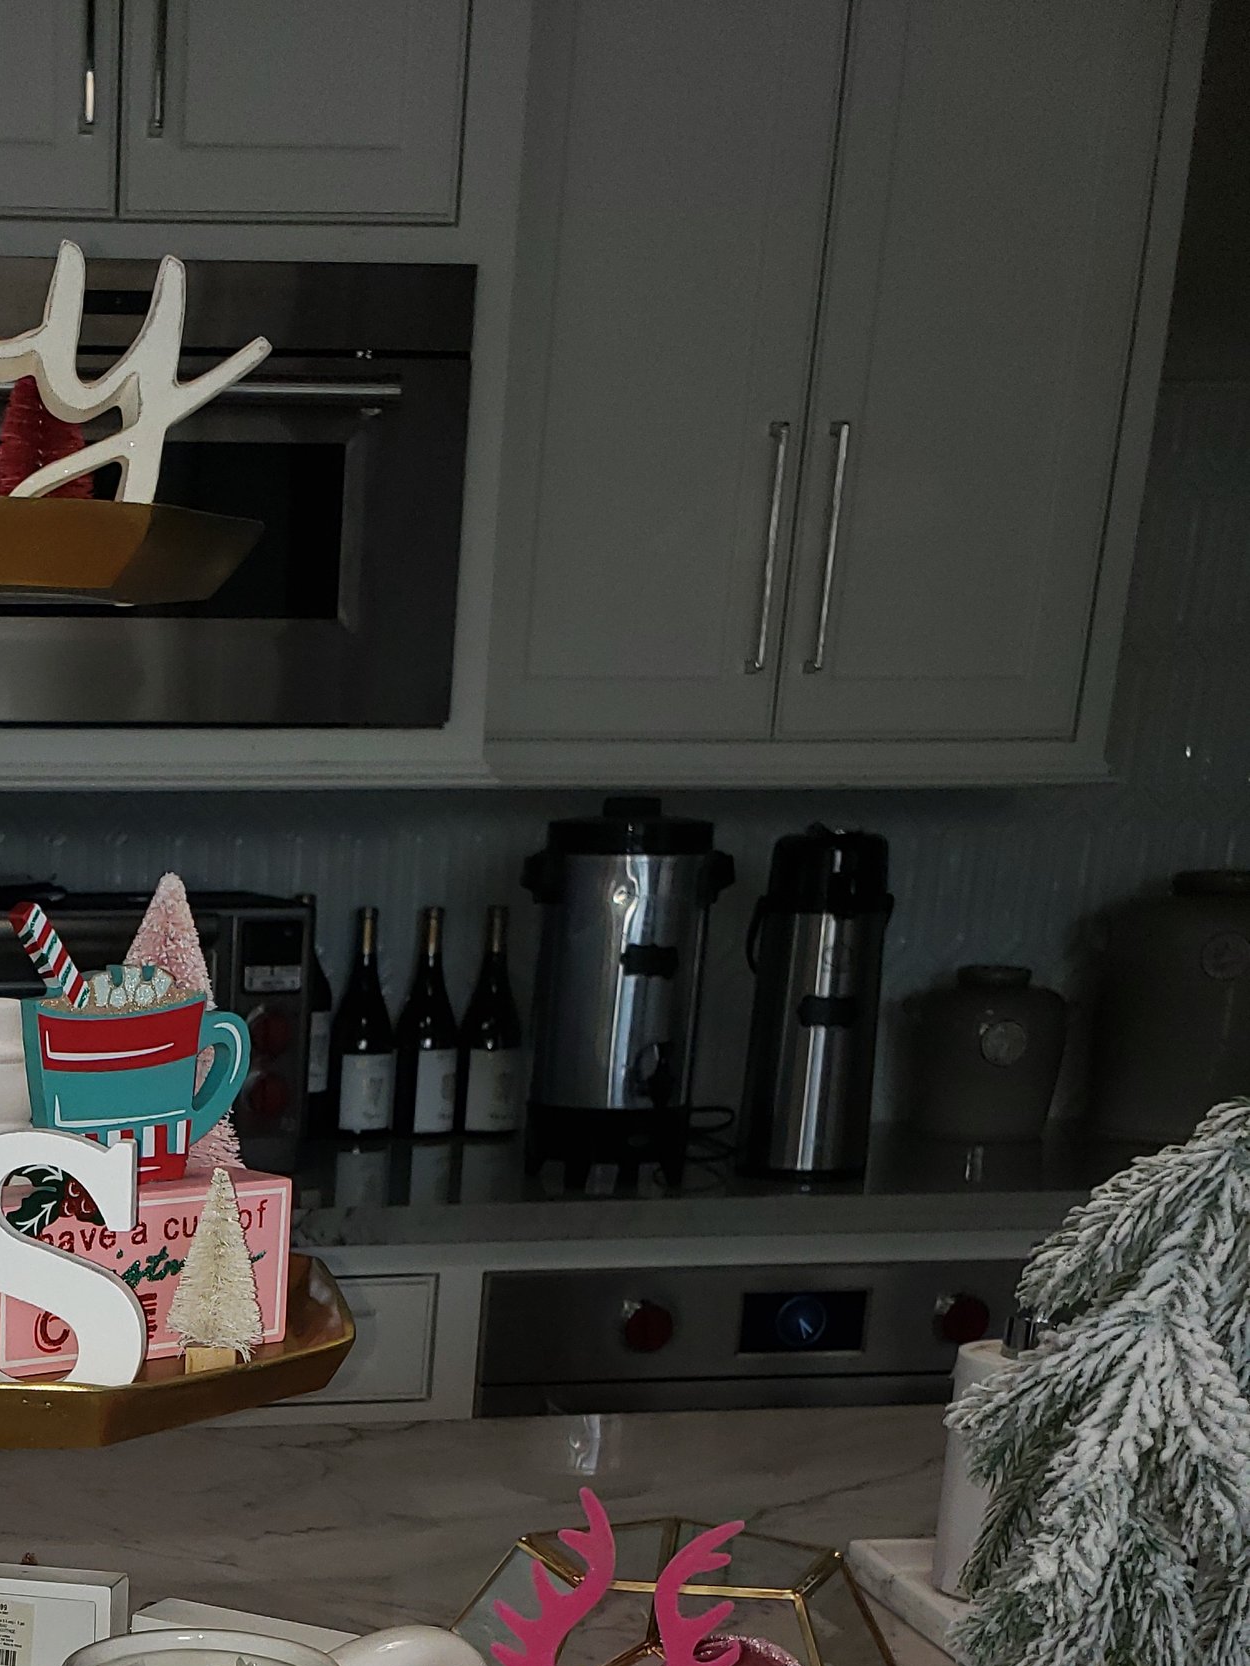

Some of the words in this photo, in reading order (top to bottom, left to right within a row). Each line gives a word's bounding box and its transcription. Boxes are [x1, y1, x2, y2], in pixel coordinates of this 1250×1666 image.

[130, 1222, 148, 1245] a
[163, 1215, 198, 1240] cu
[239, 1200, 268, 1232] of
